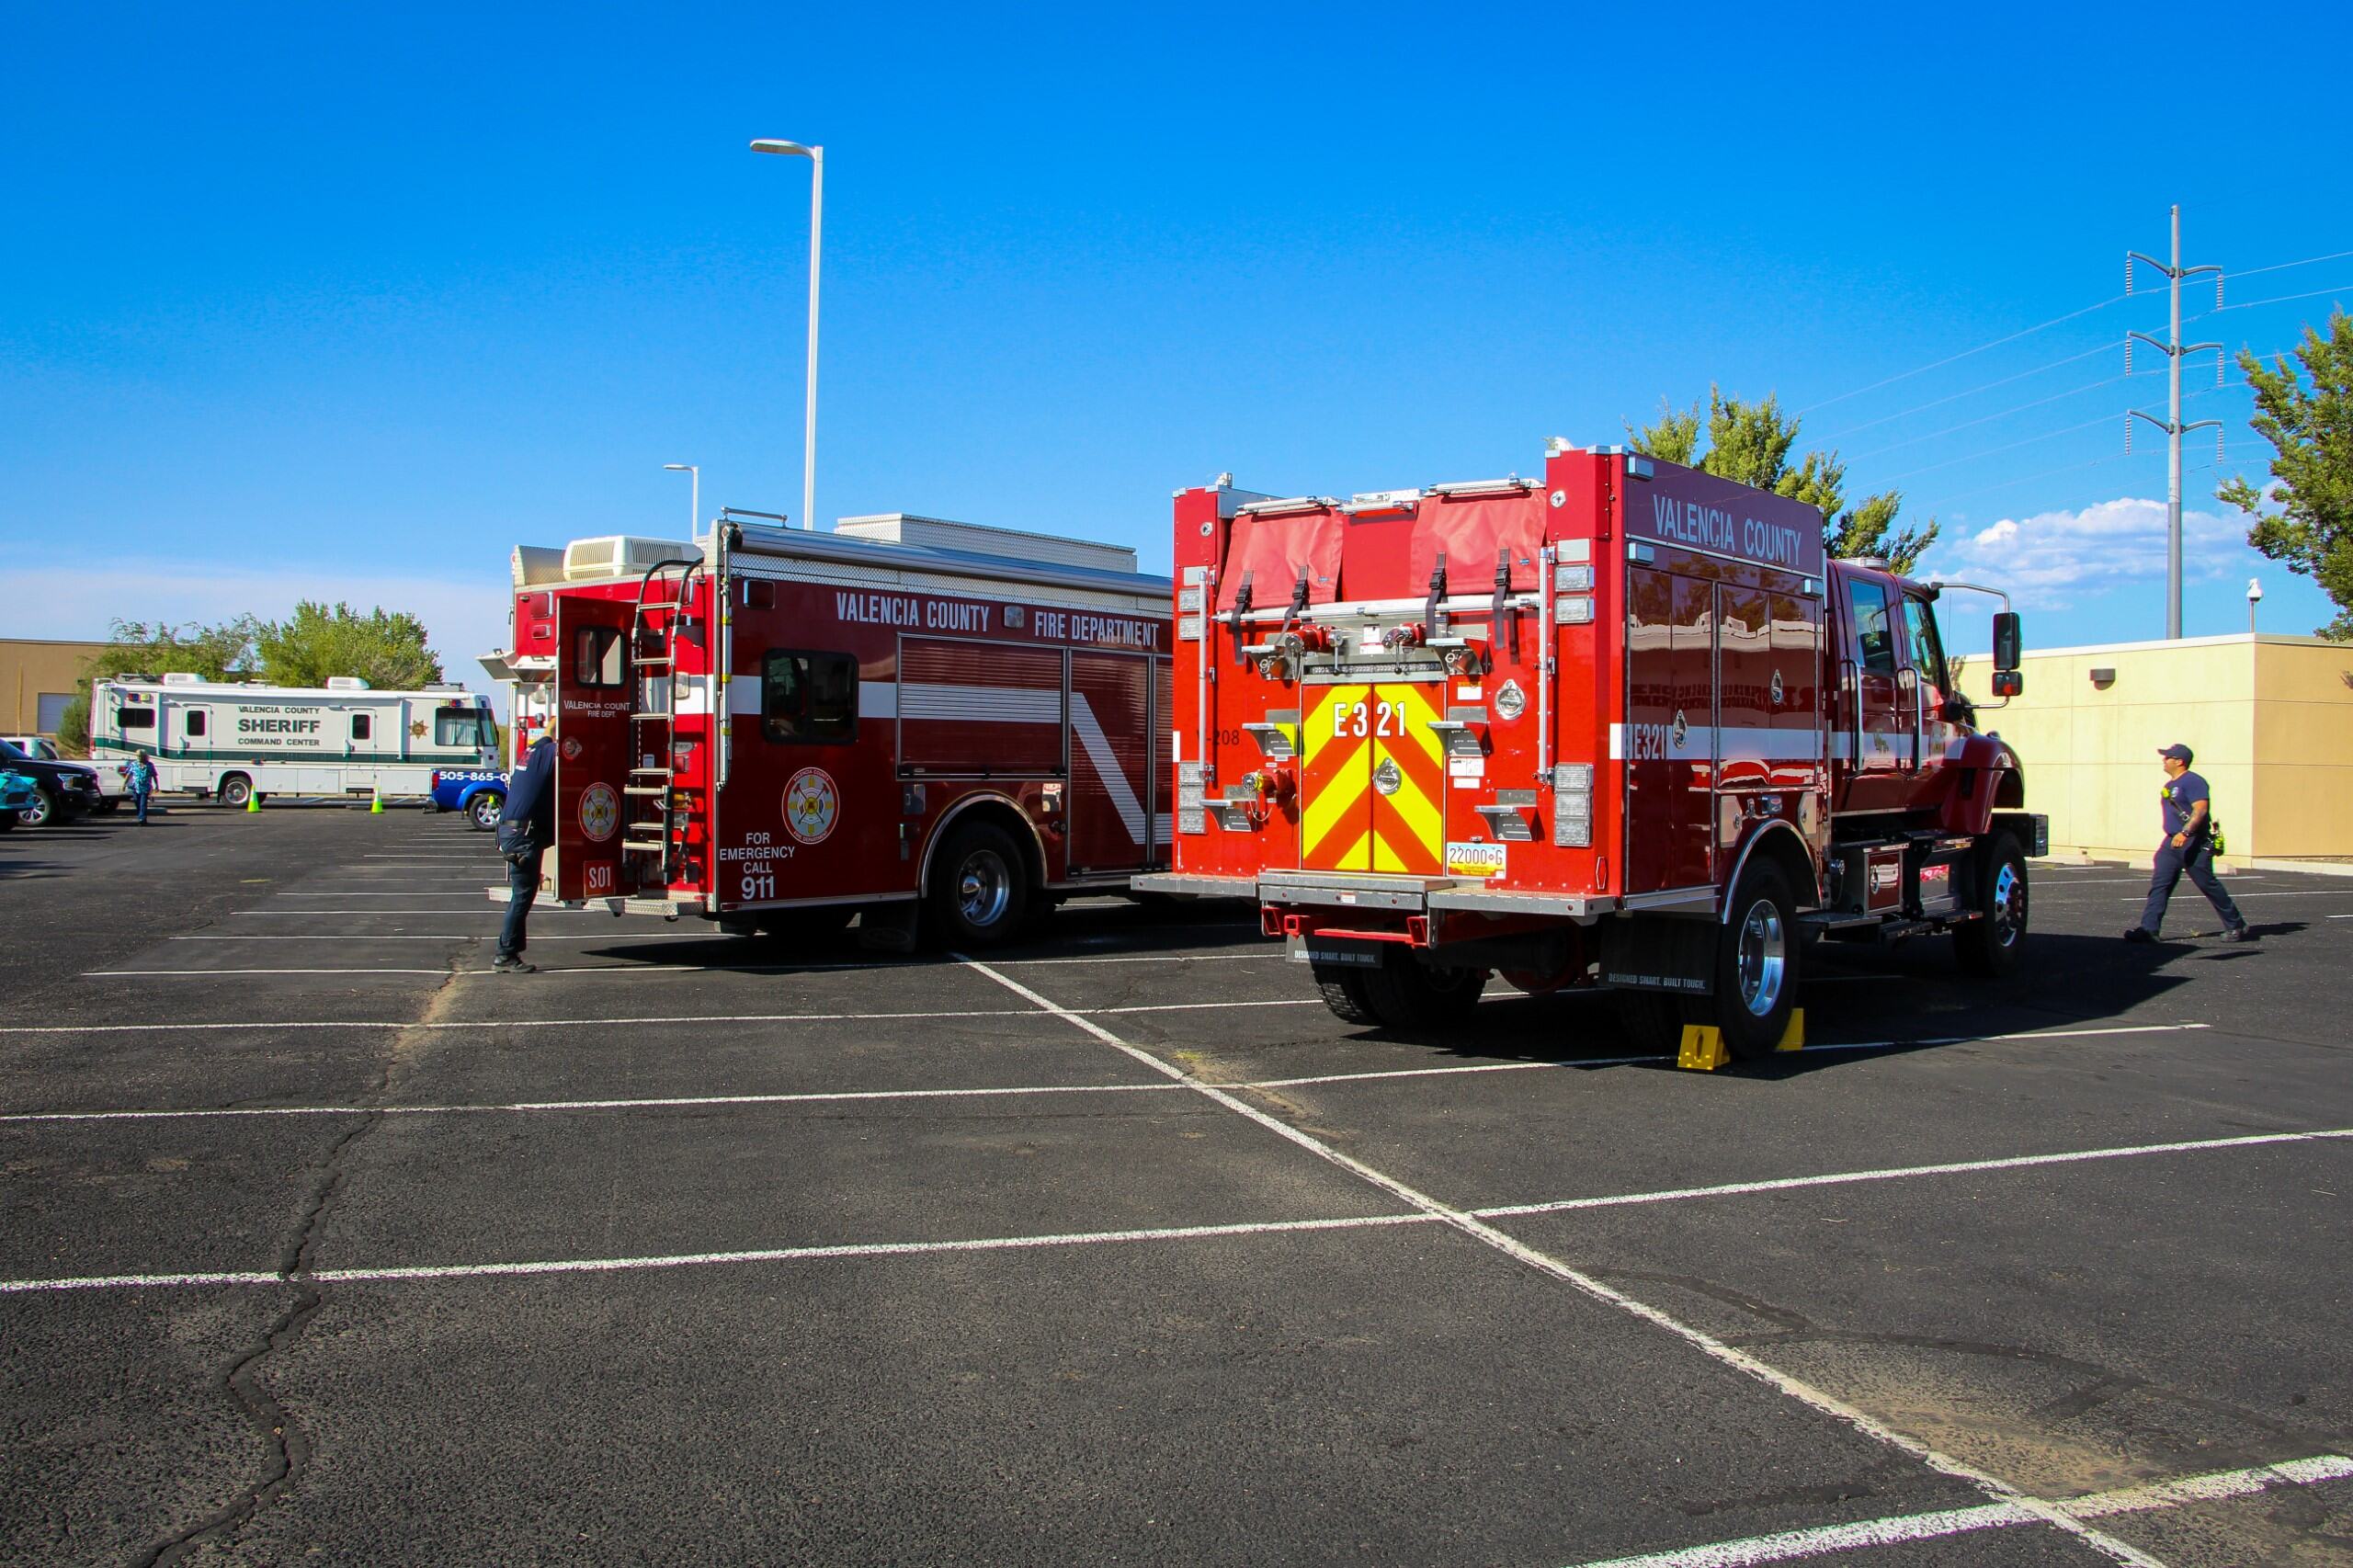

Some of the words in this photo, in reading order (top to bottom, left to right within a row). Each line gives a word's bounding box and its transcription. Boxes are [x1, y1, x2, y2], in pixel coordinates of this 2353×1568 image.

[1654, 494, 1735, 551] VALENCIA
[1745, 517, 1802, 565] COUNTY
[835, 592, 919, 627] VALENCIA
[926, 601, 990, 632] COUNTY
[1035, 611, 1066, 639] FIRE
[1072, 615, 1159, 647] DEPARTMENT
[238, 706, 280, 714] VALENCIA
[563, 699, 601, 710] VALENCIA
[603, 702, 631, 711] COUNT
[1334, 700, 1405, 737] E321
[239, 719, 321, 733] SHERIFF
[286, 738, 320, 746] CENTER
[1198, 730, 1240, 745] -208
[745, 832, 770, 845] FOR
[720, 846, 795, 860] EMERGENCY
[743, 861, 773, 874] CALL
[588, 866, 611, 889] S01
[741, 875, 774, 900] 911
[1294, 949, 1319, 960] DESIGNED
[1608, 972, 1637, 984] DESIGNED
[1663, 977, 1681, 988] BUILT
